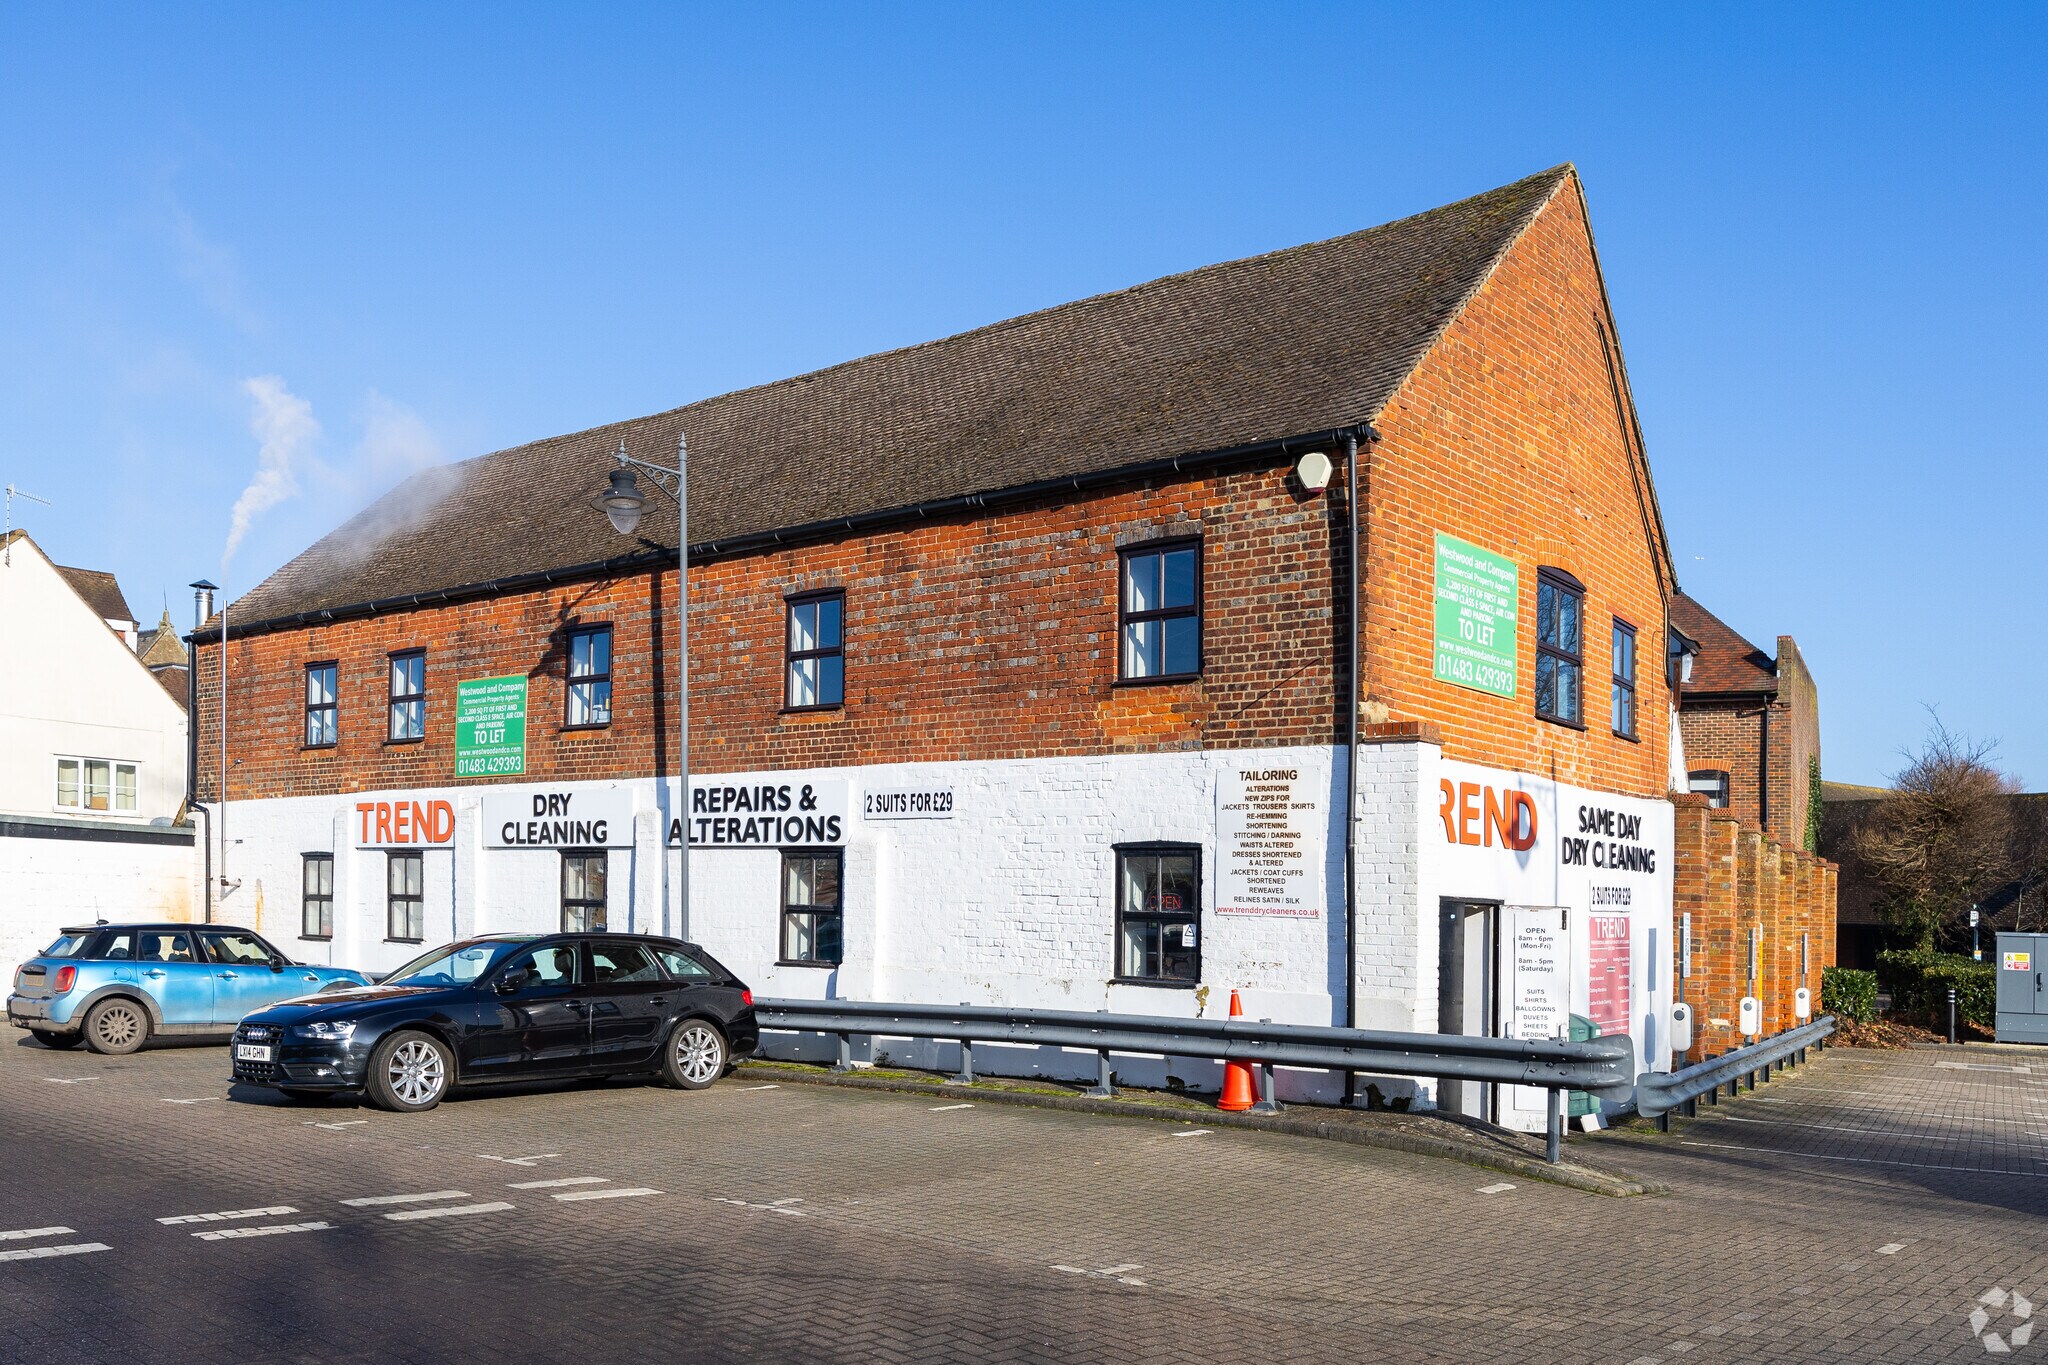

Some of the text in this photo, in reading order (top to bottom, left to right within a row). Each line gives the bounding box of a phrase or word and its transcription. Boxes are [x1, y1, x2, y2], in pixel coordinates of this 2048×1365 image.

[1439, 543, 1515, 585] Westwood and Company
[1444, 562, 1510, 594] Commercial Property Agents
[1438, 588, 1515, 621] SECOND CLASS E SPACE, AIR CON
[1462, 584, 1469, 596] SQ
[1470, 587, 1475, 596] FT
[1477, 589, 1483, 598] OF
[1484, 592, 1496, 603] FIRST
[1497, 596, 1508, 607] AND
[1460, 607, 1494, 625] AND PARKING
[1458, 618, 1495, 647] TO LET
[1439, 640, 1513, 668] www.westwoodandco.com
[1439, 654, 1512, 692] 01483 429393
[460, 683, 524, 696] Westwood and Company
[474, 729, 505, 744] TO LET
[459, 746, 521, 756] www.westwoodandco.com
[459, 756, 521, 774] 01483 429393
[1239, 770, 1297, 781] TAILORING
[533, 793, 572, 817] DRY
[693, 784, 817, 813] REPAIRS &
[867, 792, 952, 812] 2 SUITS FOR £29
[356, 800, 454, 843] TREND
[502, 820, 607, 844] CLEANING
[668, 815, 841, 843] ALTERATIONS
[1579, 805, 1641, 841] SAME DAY
[1562, 837, 1655, 874] DRY CLEANING
[1592, 887, 1595, 904] 2
[1597, 887, 1611, 904] SUITS
[1612, 887, 1622, 904] FOR
[1217, 906, 1319, 917] www.trenddrycleaners.co.uk
[1595, 918, 1626, 938] TREND
[240, 1046, 264, 1058] LX14 GHN
